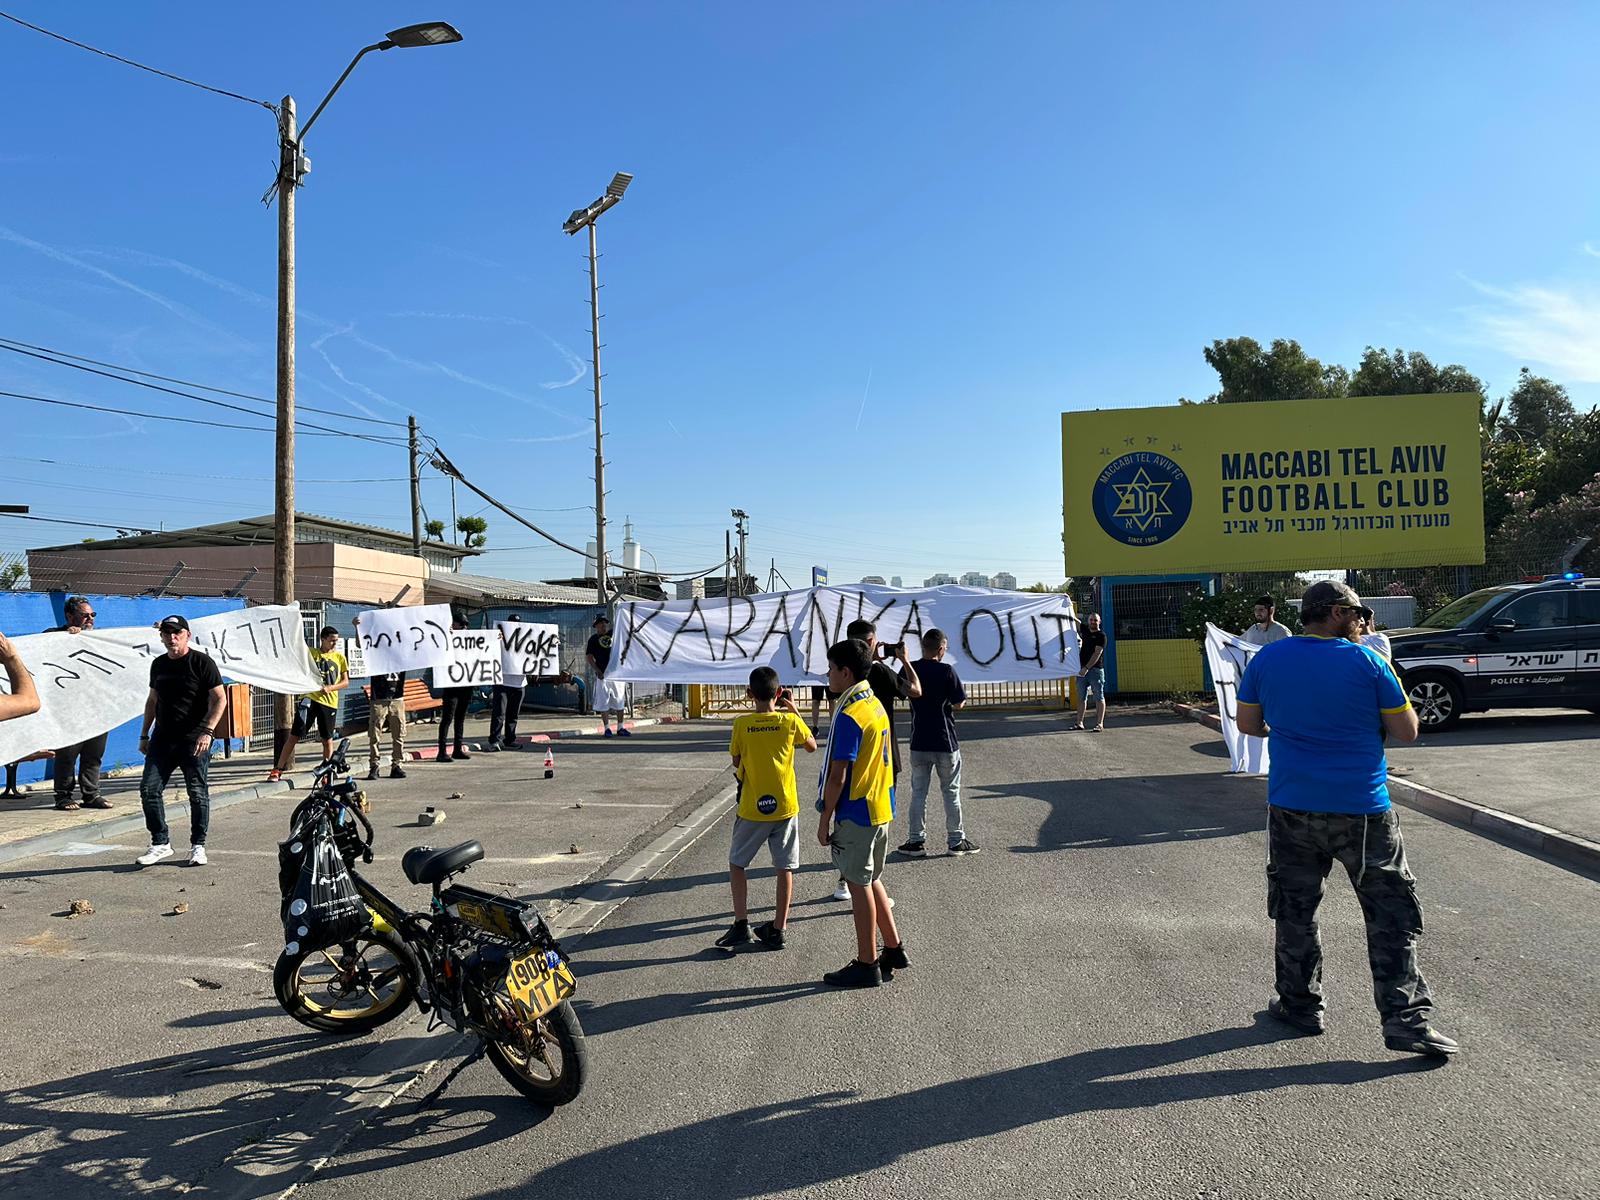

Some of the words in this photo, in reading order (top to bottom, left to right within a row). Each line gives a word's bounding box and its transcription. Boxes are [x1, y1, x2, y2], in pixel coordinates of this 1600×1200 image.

[1099, 455, 1134, 485] MACCABI
[1136, 453, 1151, 463] TEL
[1153, 455, 1174, 471] AVIV
[1172, 466, 1184, 480] FC
[1222, 449, 1330, 480] MACCABI
[1338, 447, 1383, 476] TEL
[1391, 444, 1447, 474] AVIV
[1222, 482, 1365, 513] FOOTBALL
[1378, 478, 1449, 508] CLUB
[1223, 519, 1258, 534] אביב
[1265, 517, 1284, 533] תל
[1291, 517, 1326, 532] מכבי
[1332, 515, 1394, 531] הכדורגל
[1401, 513, 1450, 531] מועדון
[452, 635, 490, 652] ame,
[961, 608, 1078, 668] OUT
[522, 657, 550, 679] UP
[1506, 653, 1564, 667] ישראל
[448, 659, 502, 685] OVER
[1490, 677, 1525, 685] POLICE
[747, 725, 781, 733] Hisense
[511, 951, 548, 991] 1906
[514, 970, 572, 1020] MTA
